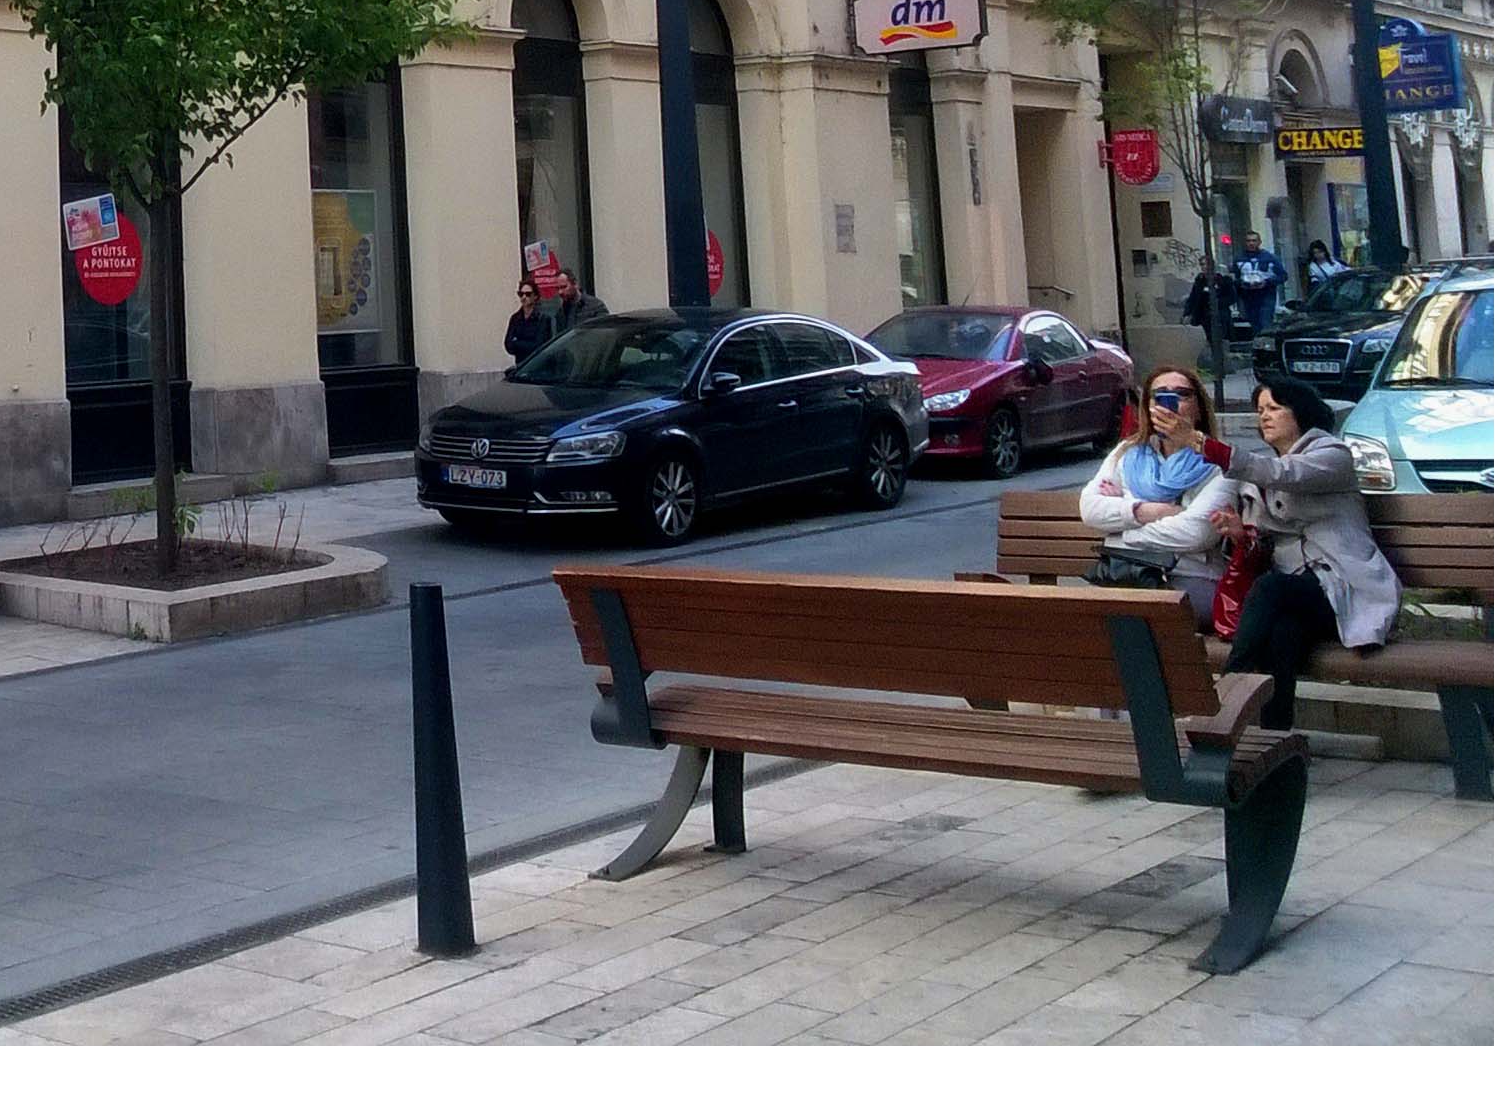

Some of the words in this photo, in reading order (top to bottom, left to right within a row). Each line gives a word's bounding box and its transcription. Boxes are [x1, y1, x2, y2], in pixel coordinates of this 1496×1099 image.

[1277, 129, 1364, 151] CHANGE
[83, 259, 89, 268] A
[92, 258, 136, 269] PONTOKAT
